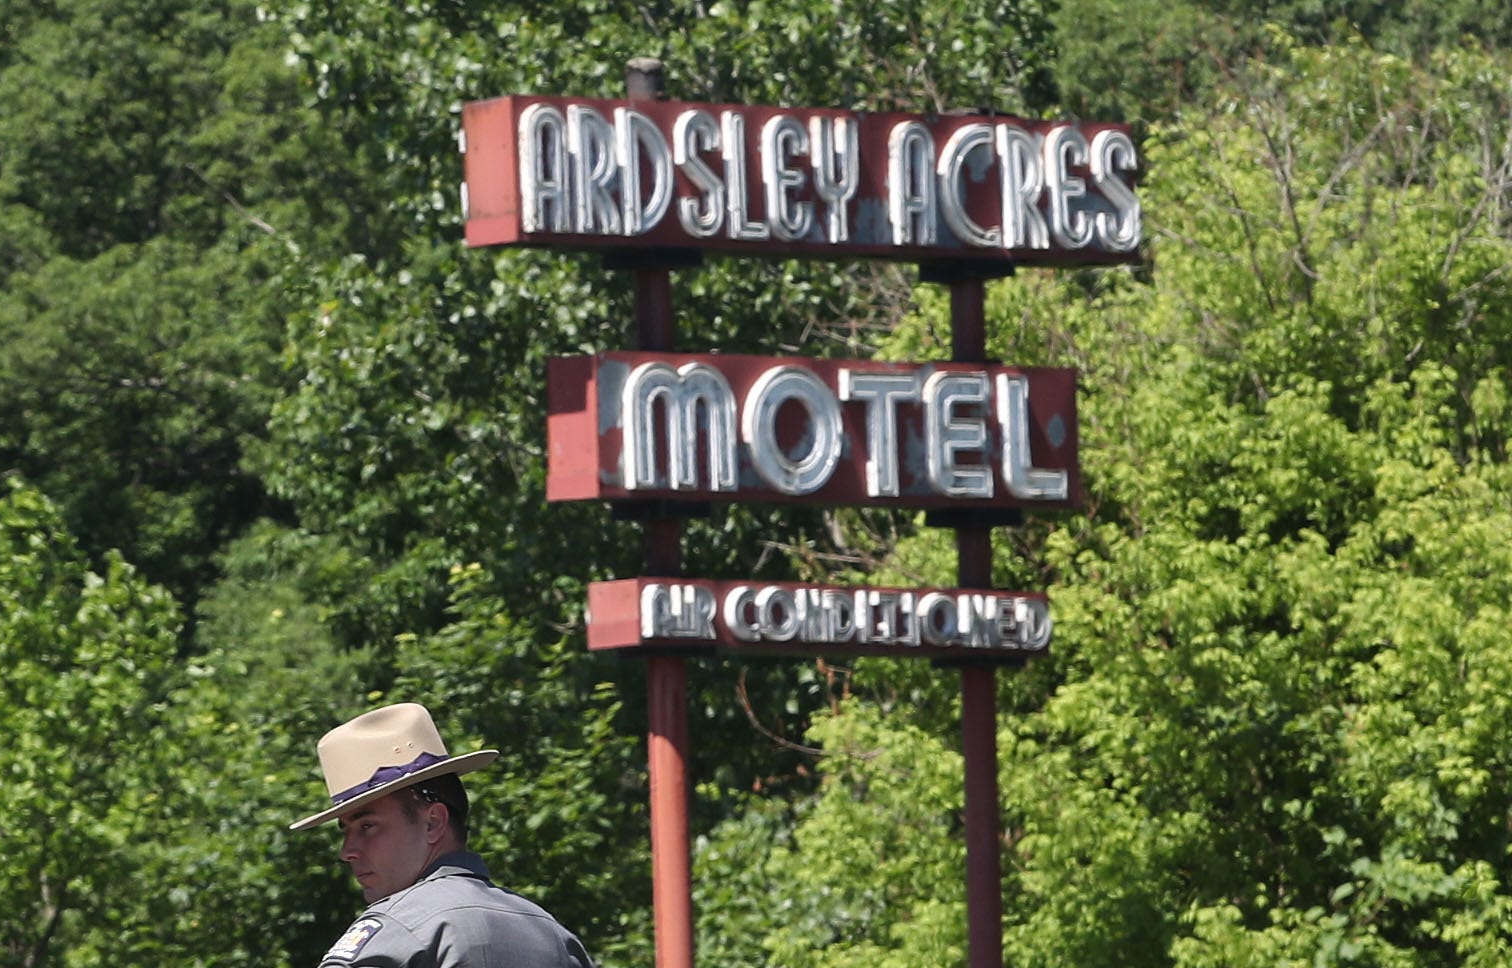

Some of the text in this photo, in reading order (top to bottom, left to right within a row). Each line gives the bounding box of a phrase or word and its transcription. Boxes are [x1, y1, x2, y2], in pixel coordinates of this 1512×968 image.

[518, 102, 1142, 252] ARDSLEY ACRES
[622, 361, 1069, 500] MOTEL
[640, 582, 1054, 652] AIR CONDITIONED
